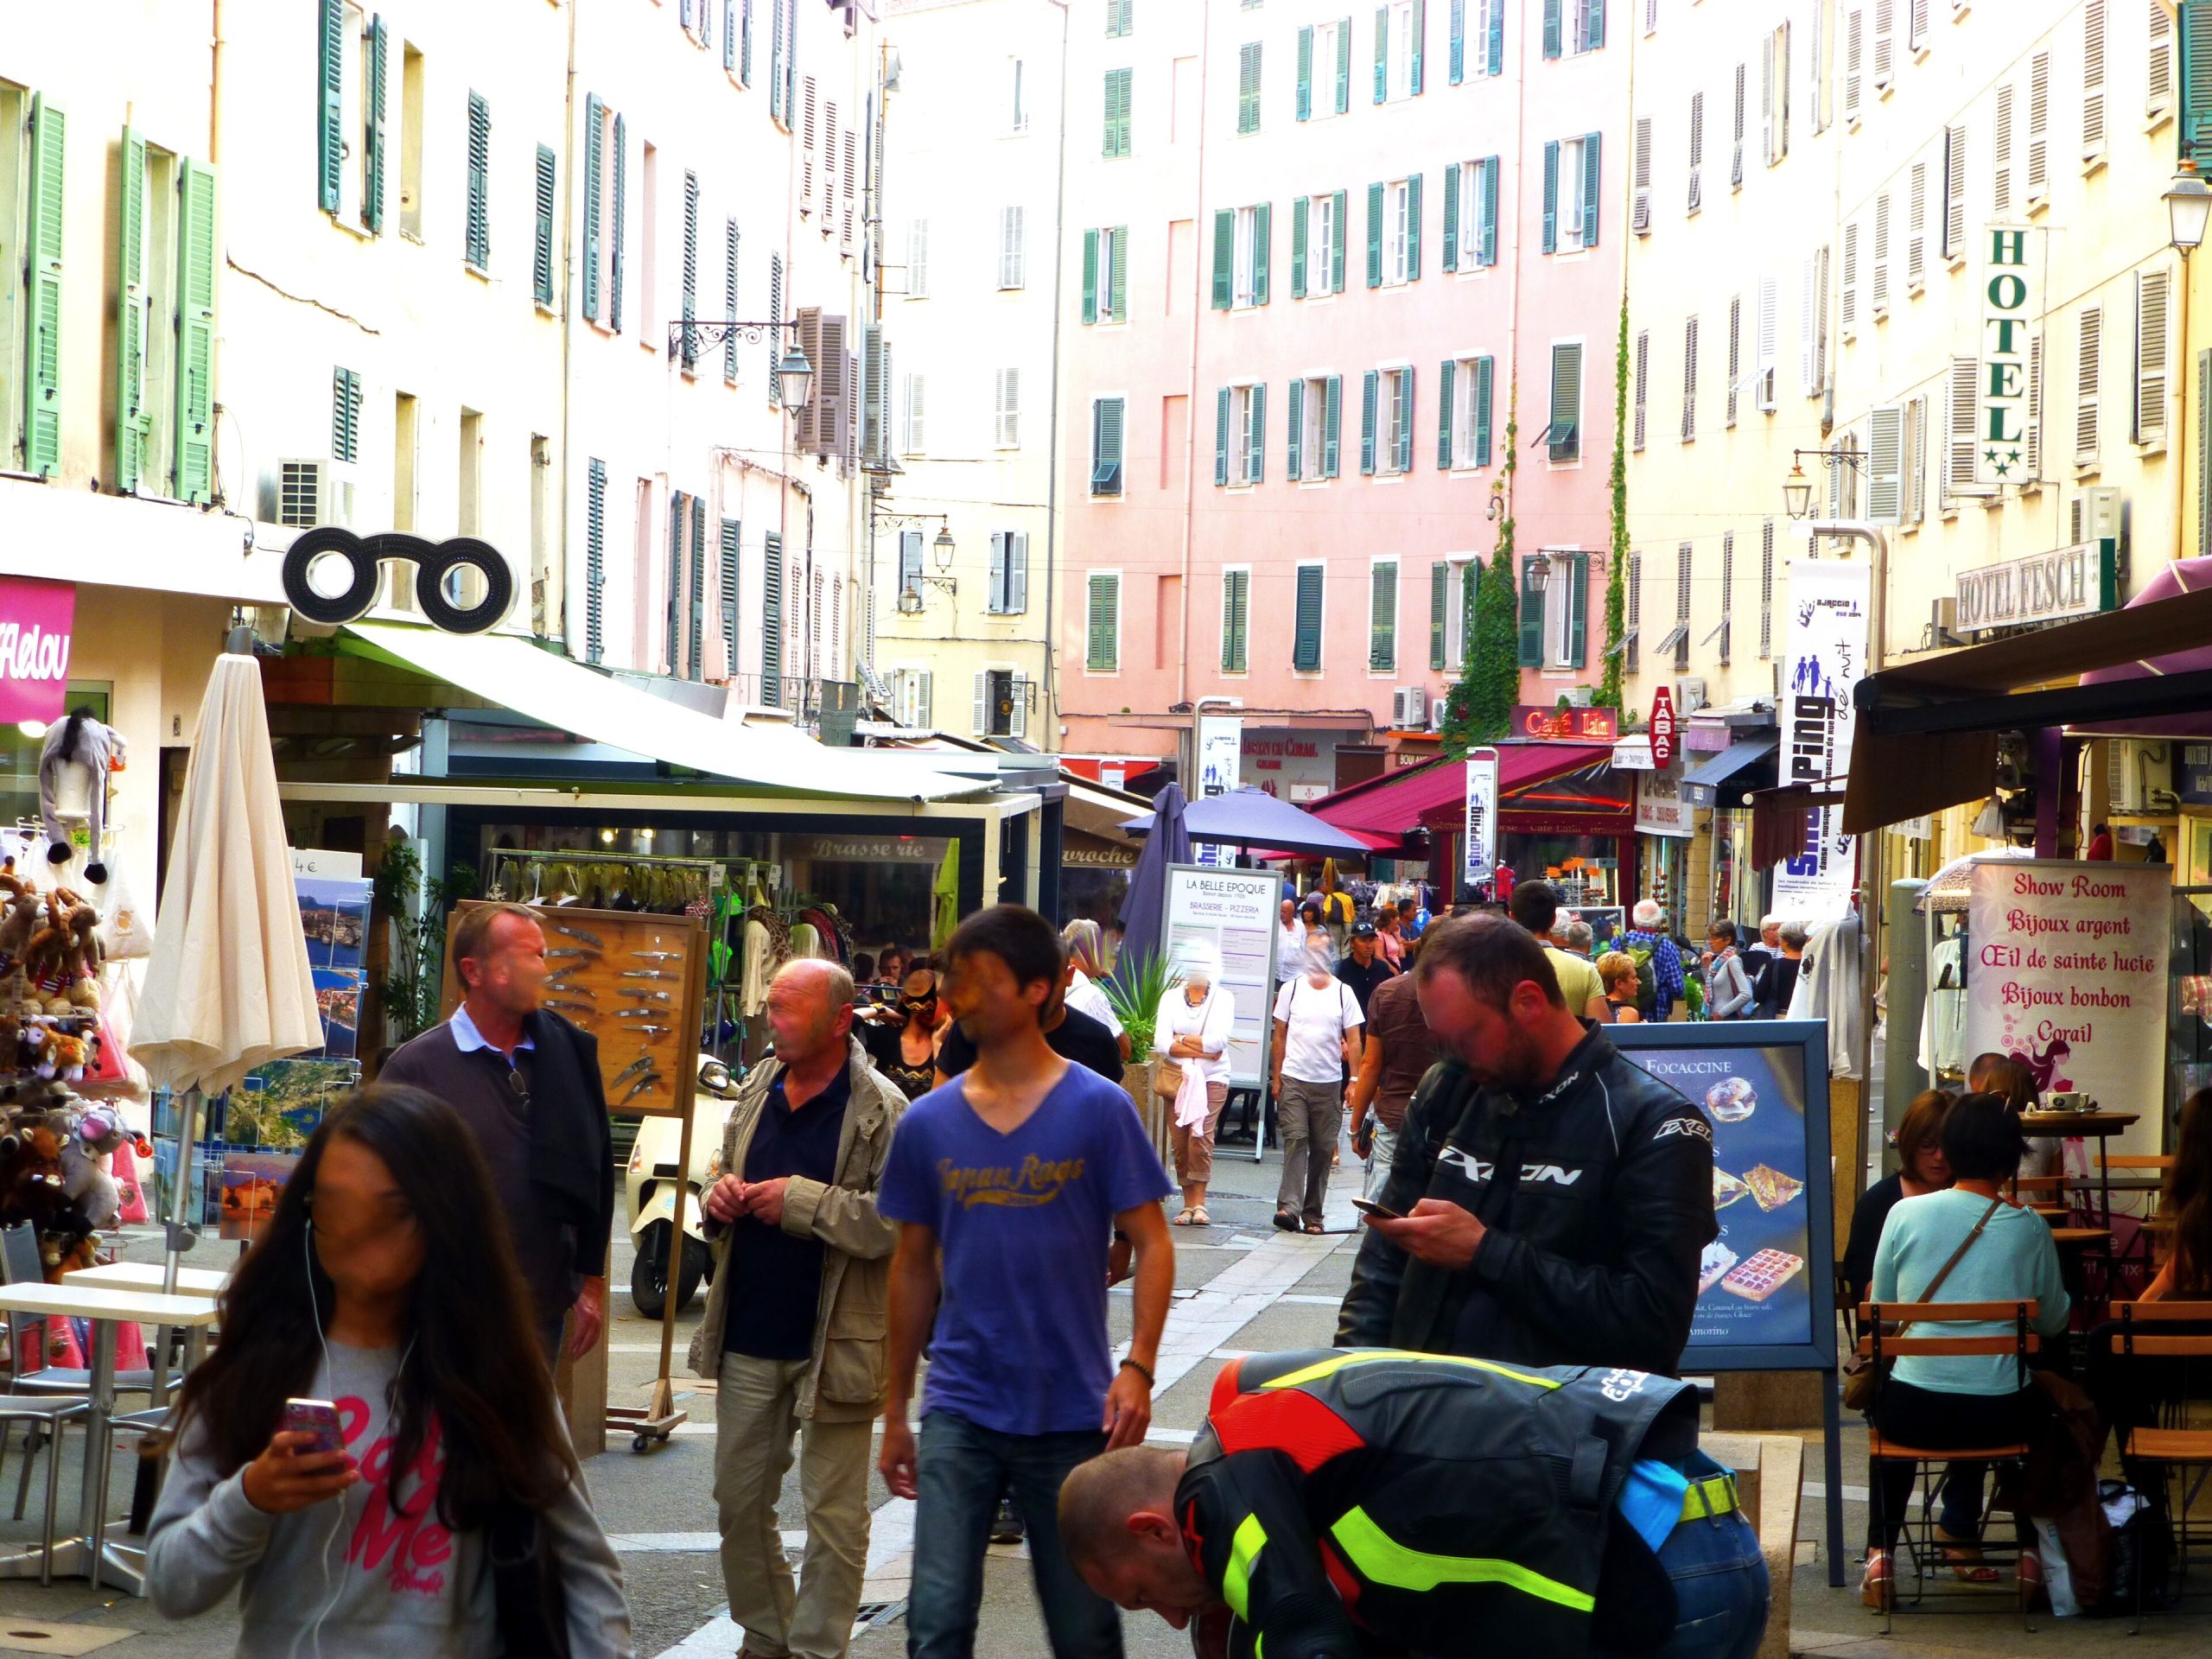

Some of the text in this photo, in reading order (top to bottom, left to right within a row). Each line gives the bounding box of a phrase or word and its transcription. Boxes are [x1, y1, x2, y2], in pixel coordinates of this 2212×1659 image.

[1983, 230, 2027, 442] HOTEL
[1958, 567, 2016, 626] HOTEL
[2018, 550, 2087, 617] FESCH
[1834, 639, 1852, 678] nuit
[1655, 697, 1672, 759] TABAC
[1062, 845, 1135, 864] vroche
[1819, 847, 1828, 870] danse
[1186, 880, 1266, 894] LA BELLE EPOQUE
[2013, 873, 2126, 899] Show Room
[1190, 901, 1260, 914] BRASSERIE PIZZERIA
[2007, 909, 2131, 939] Bijoux argent
[2027, 948, 2046, 969] de
[2053, 952, 2107, 971] sainte
[2113, 951, 2154, 973] lucie
[2001, 982, 2132, 1009] Bijoux bonbon
[2037, 1020, 2092, 1044] Corail
[343, 1483, 452, 1573] Me
